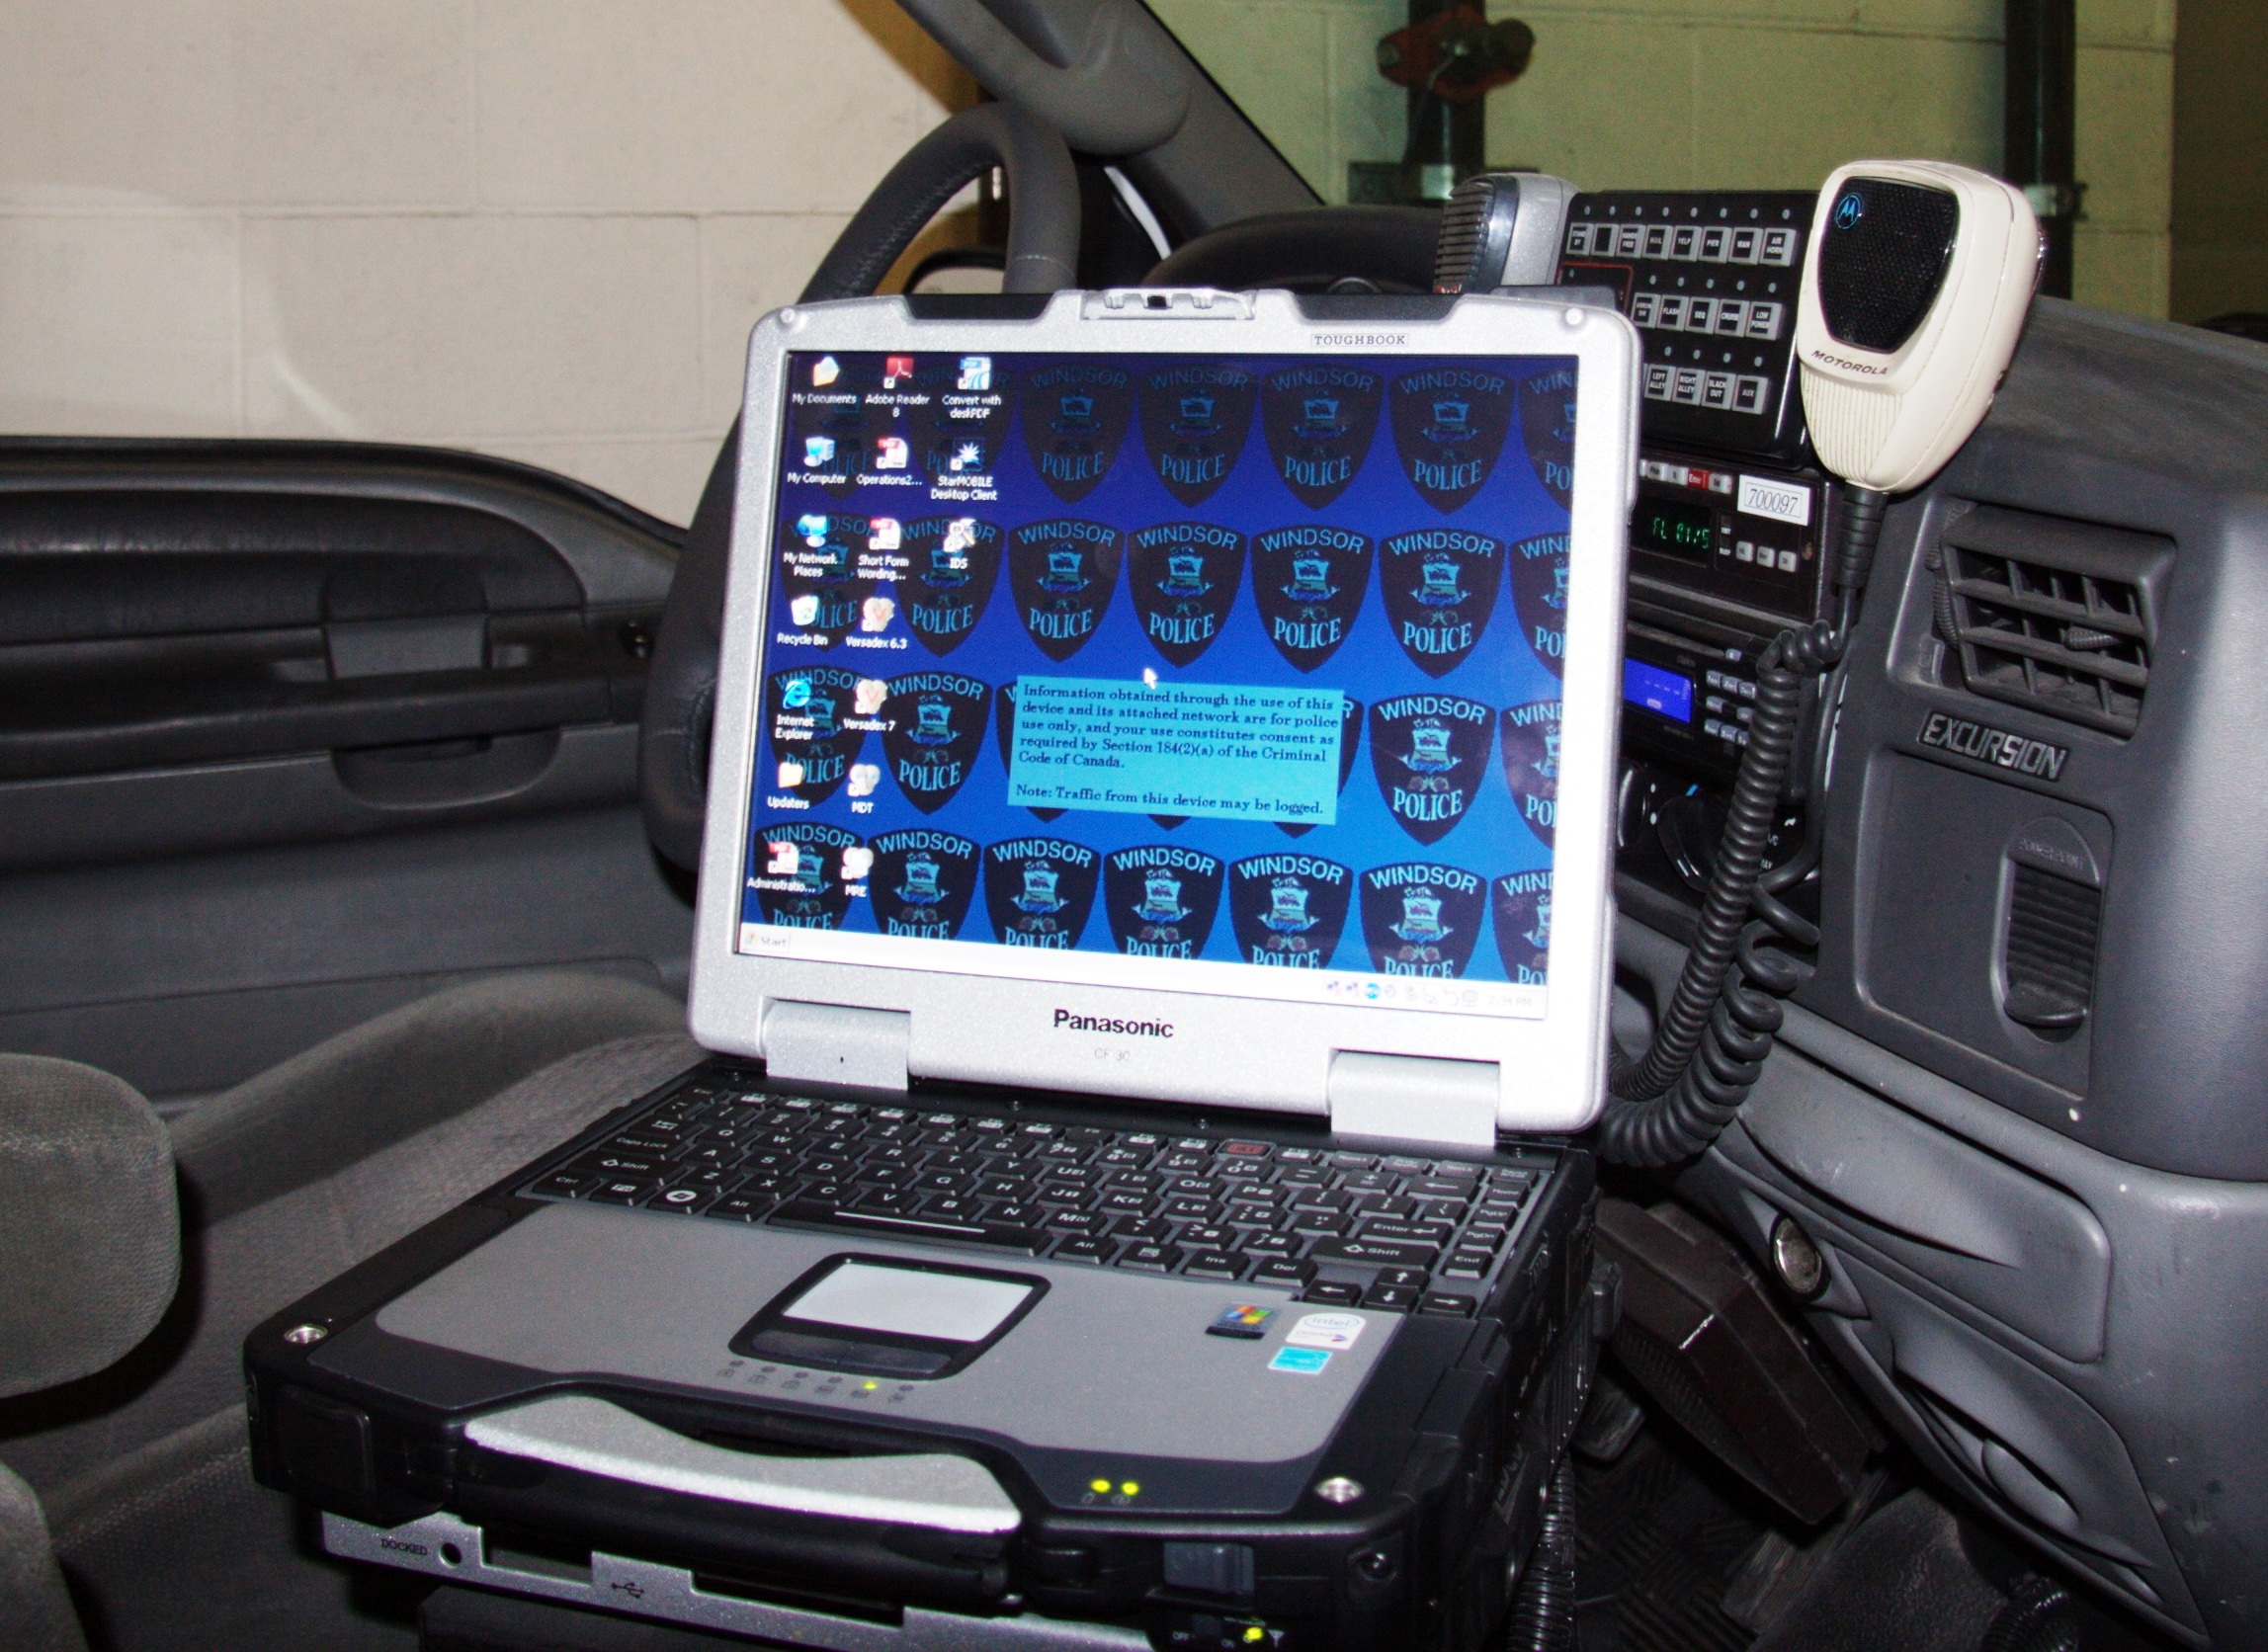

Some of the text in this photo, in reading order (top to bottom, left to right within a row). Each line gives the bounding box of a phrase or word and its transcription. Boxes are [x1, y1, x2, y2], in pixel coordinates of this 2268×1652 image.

[1314, 336, 1405, 345] TOUGHBOOK
[1811, 350, 1888, 375] MOTOROLA
[1031, 369, 1127, 388] WINDSOR
[1148, 370, 1248, 390] WINDSOR
[1271, 368, 1374, 393] WINDSOR
[1400, 371, 1504, 395] WINDSOR
[793, 394, 857, 405] My Documents
[866, 394, 930, 405] Adobe Reader
[942, 395, 1001, 406] Convert with
[892, 408, 899, 417] 8
[788, 473, 846, 485] My Computer
[1042, 452, 1104, 481] POLICE
[1162, 454, 1225, 484] POLICE
[1285, 456, 1351, 486] POLICE
[1414, 459, 1481, 490] POLICE
[931, 489, 996, 501] Desktop Client
[1749, 488, 1798, 514] 700097
[1018, 522, 1115, 547] WINDSOR
[1137, 525, 1237, 550] WINDSOR
[1261, 529, 1364, 555] WINDSOR
[1388, 533, 1494, 558] WINDSOR
[784, 553, 837, 564] My Network
[859, 555, 909, 566] Short Form
[795, 567, 823, 577] Places
[912, 604, 972, 633] POLICE
[1030, 609, 1092, 638] POLICE
[1149, 613, 1215, 644] POLICE
[778, 633, 827, 646] Recycle Bin
[890, 637, 907, 649] 6.3
[1275, 617, 1340, 649] POLICE
[1403, 621, 1471, 654] POLICE
[888, 674, 984, 700] WINDSOR
[1024, 685, 1332, 709] Information obtained through the use of this
[777, 715, 814, 727] Internet
[1023, 702, 1338, 729] device and its attached network are for police
[1379, 698, 1485, 725] WINDSOR
[775, 728, 812, 740] Explorer
[1022, 720, 1334, 745] use only, and your use constitutes consent as
[1020, 735, 1326, 762] required by Section 184(2)(a) of the Criminal
[1924, 714, 2065, 779] EXCURSION
[1020, 752, 1125, 769] Code of Canada.
[899, 759, 961, 791] POLICE
[1017, 785, 1322, 815] Note: Traffic from this device may be logged.
[1393, 787, 1463, 821] POLICE
[763, 826, 855, 848] WINDSOR
[877, 832, 972, 859] WINDSOR
[992, 840, 1091, 867] WINDSOR
[1114, 848, 1216, 876] WINDSOR
[1238, 857, 1343, 885] WINDSOR
[1369, 866, 1477, 894] WINDSOR
[761, 936, 787, 948] Start
[1054, 1009, 1174, 1037] Panasonic
[620, 1161, 649, 1171] Shift
[556, 1176, 578, 1185] Ctrl
[1373, 1223, 1409, 1232] Enter
[1368, 1247, 1399, 1256] Shift
[1312, 1317, 1350, 1326] intel
[380, 1537, 428, 1556] DOCKED
